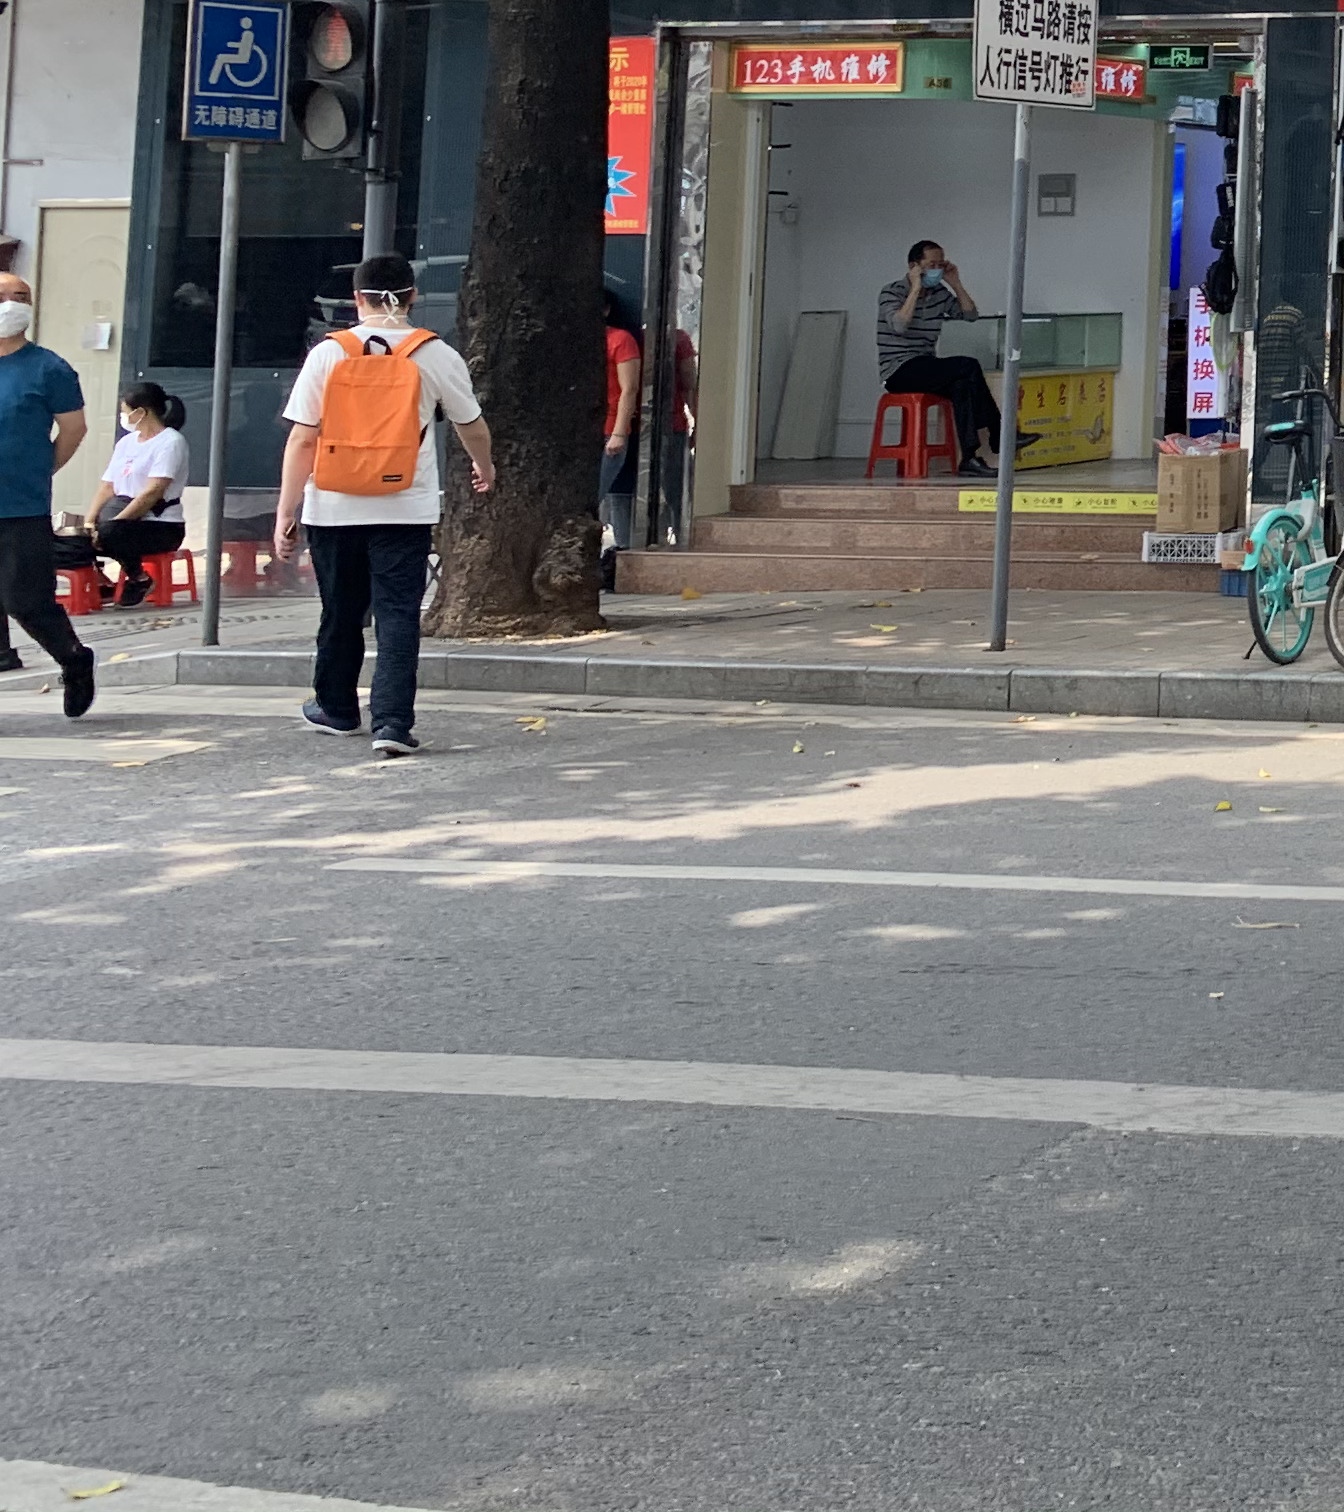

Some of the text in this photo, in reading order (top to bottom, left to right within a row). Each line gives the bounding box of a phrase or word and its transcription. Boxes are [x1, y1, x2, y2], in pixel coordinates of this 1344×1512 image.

[743, 53, 891, 85] 123手机维修
[980, 45, 1090, 95] 人行信号灯推行
[1096, 65, 1138, 97] 维修
[194, 104, 278, 130] 无障碍通道
